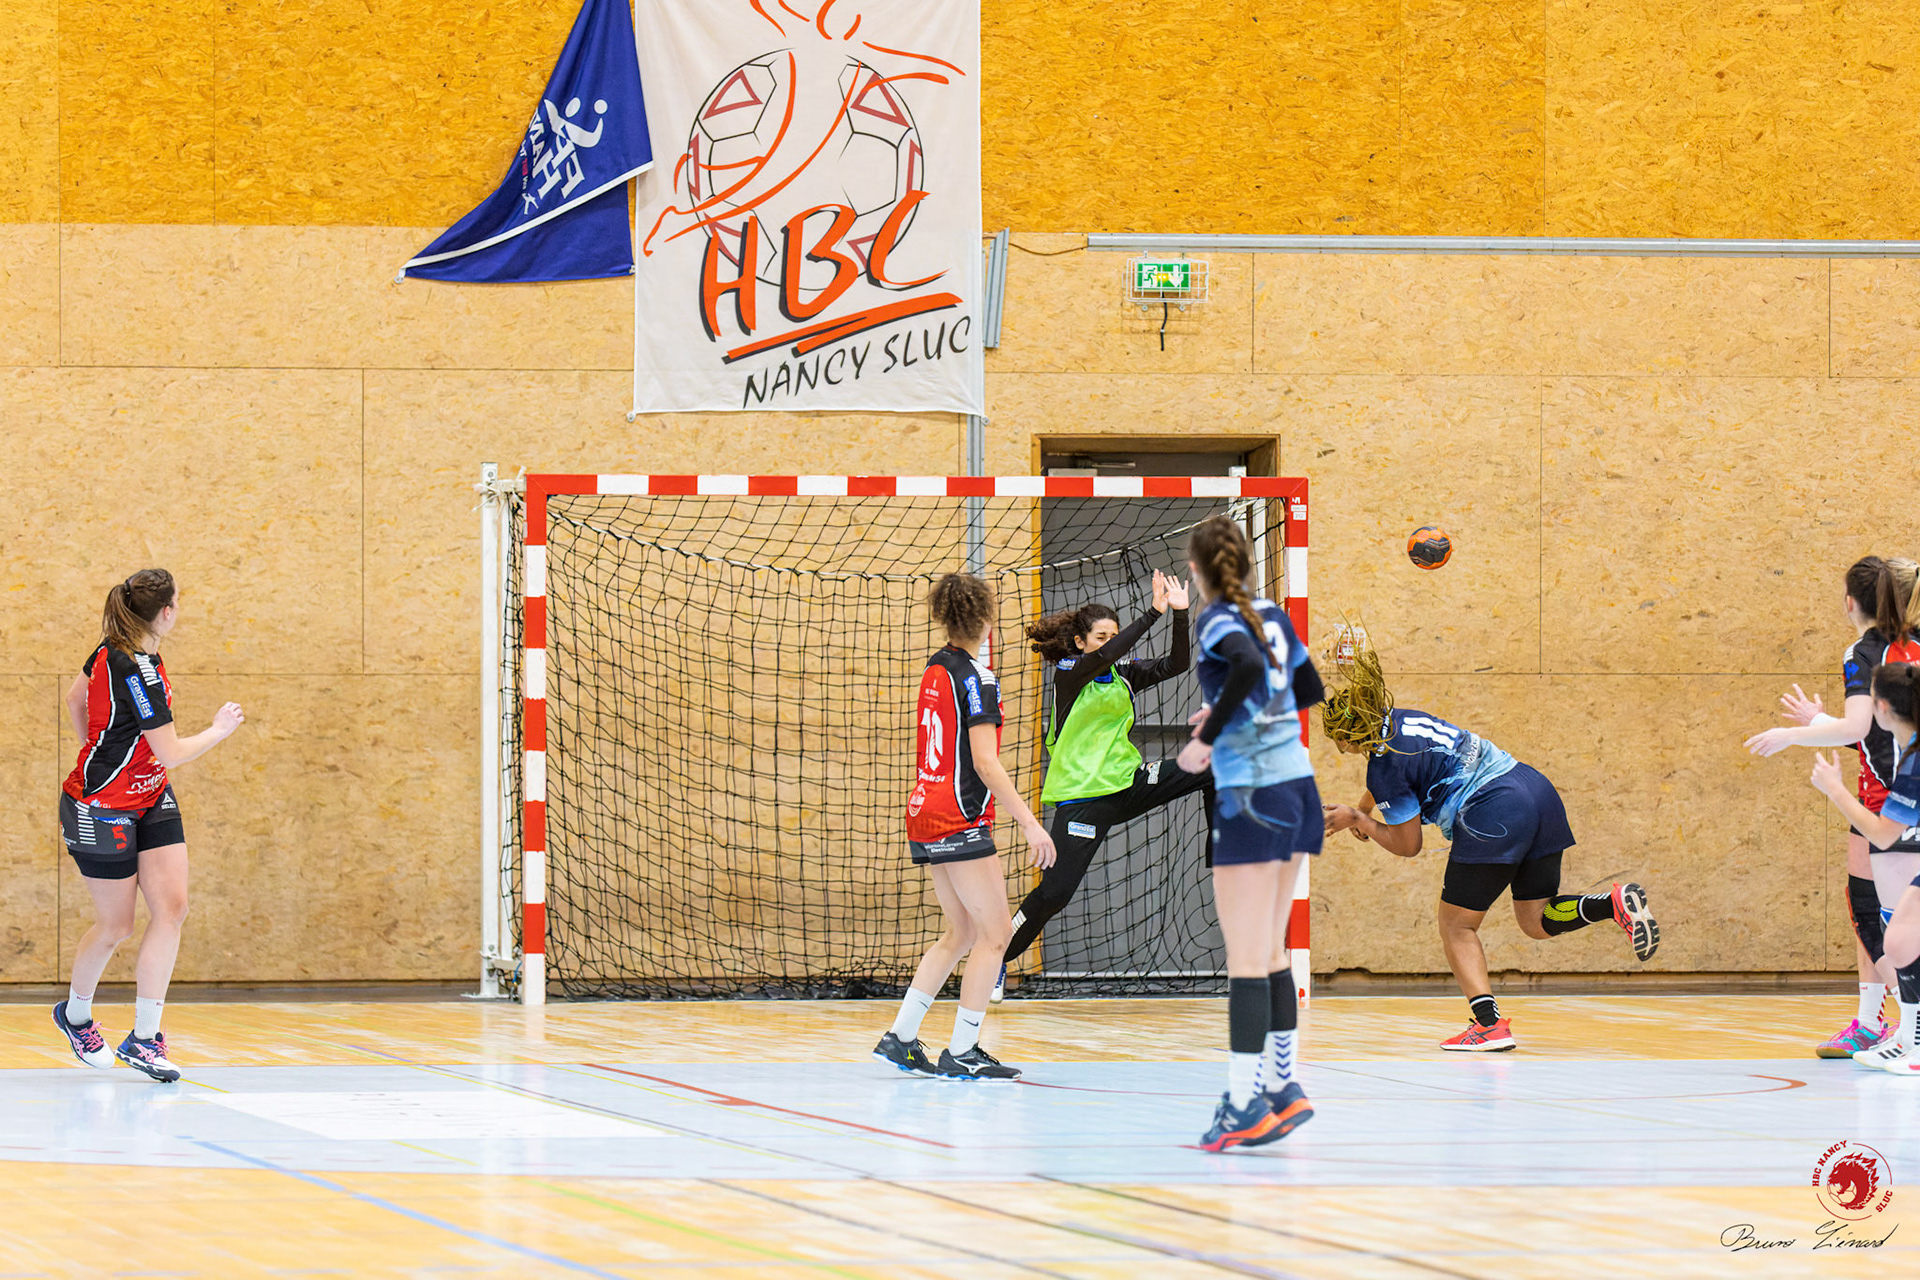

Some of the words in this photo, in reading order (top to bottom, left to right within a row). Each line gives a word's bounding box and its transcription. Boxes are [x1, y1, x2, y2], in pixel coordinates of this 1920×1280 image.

[699, 190, 951, 342] HBC
[743, 340, 871, 409] NANCY
[883, 316, 971, 374] SLUC
[1401, 716, 1460, 750] 11
[111, 824, 127, 850] 5
